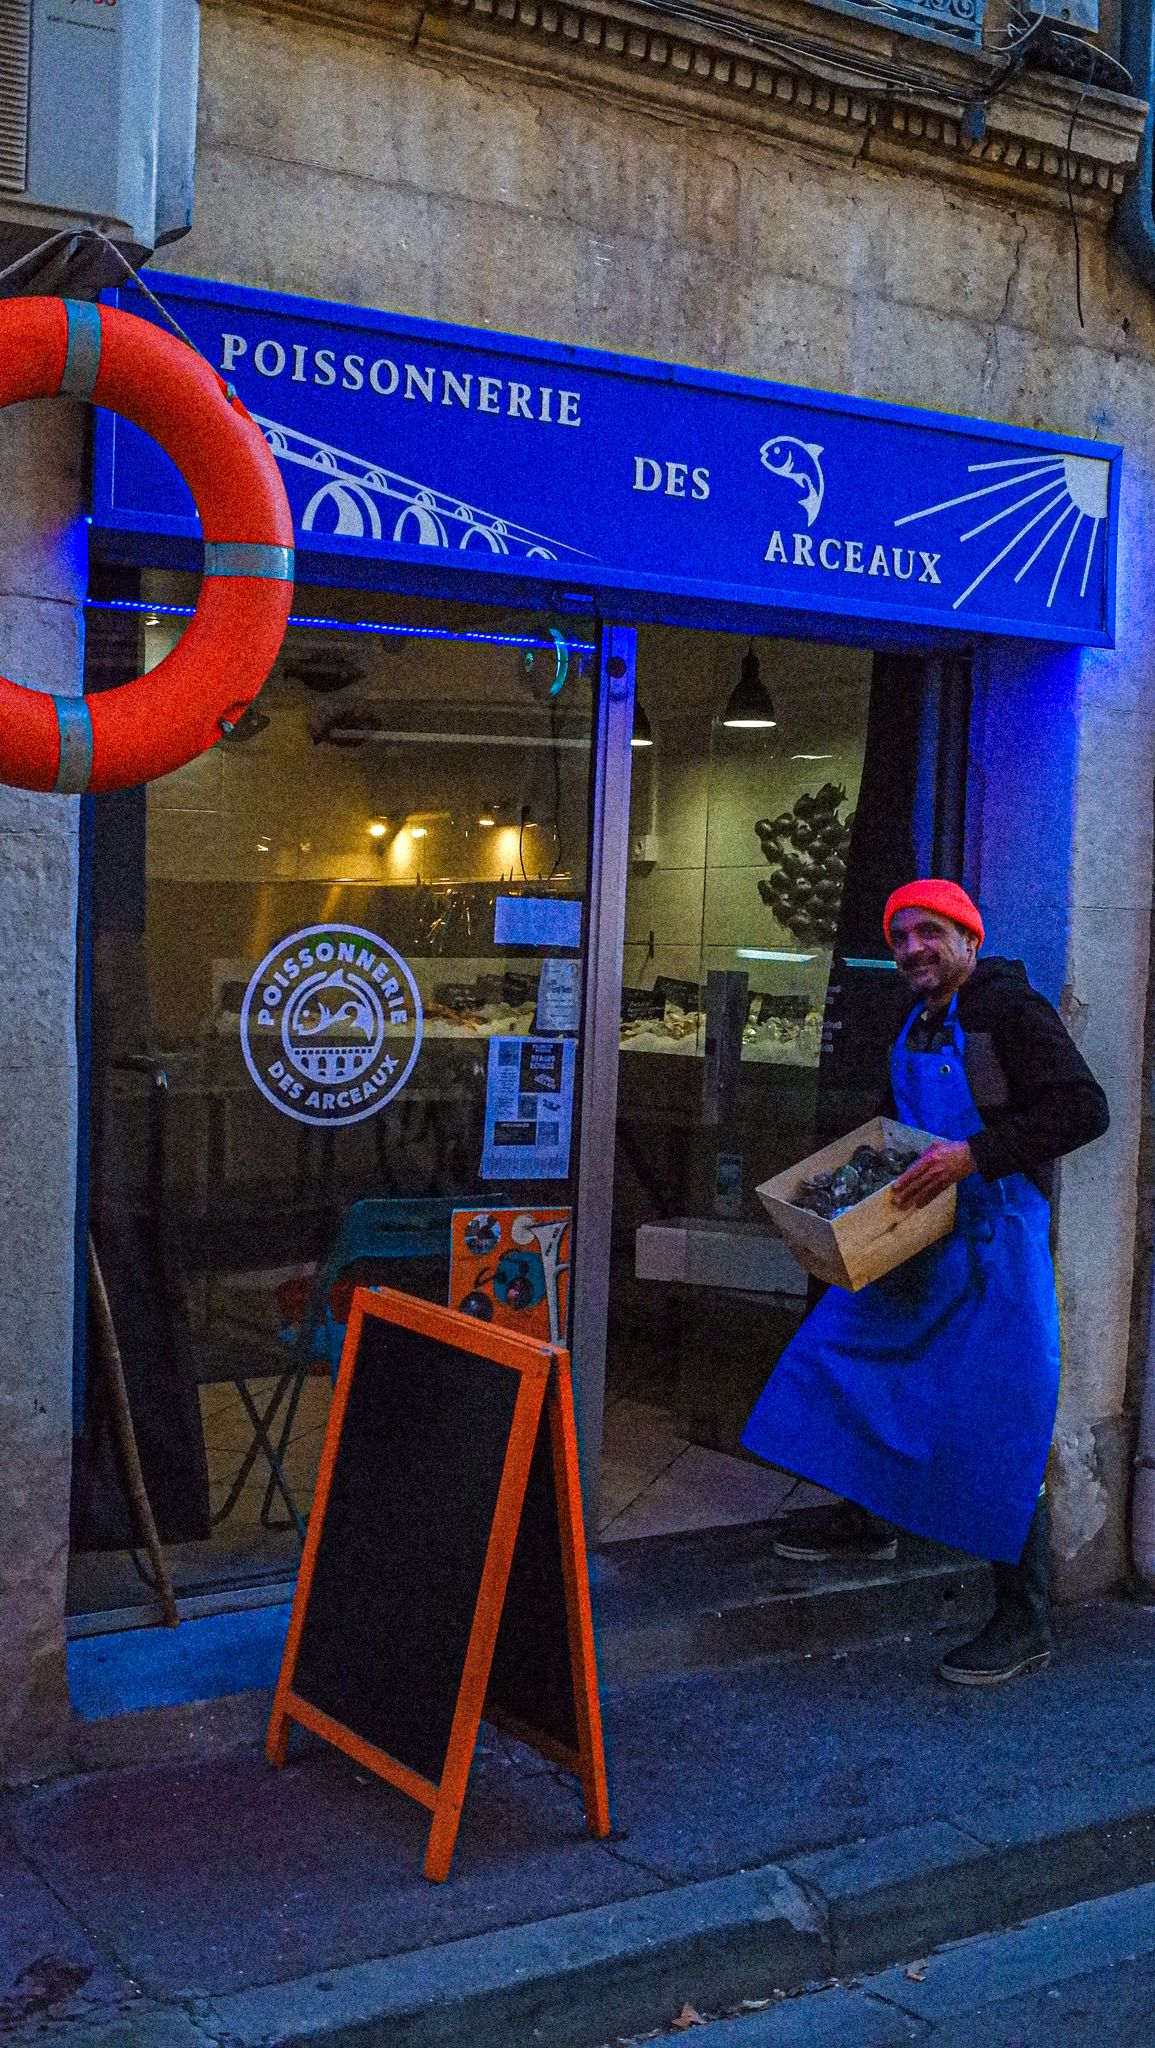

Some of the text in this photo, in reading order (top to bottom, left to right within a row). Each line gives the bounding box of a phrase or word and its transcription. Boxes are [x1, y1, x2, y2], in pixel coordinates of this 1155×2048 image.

[221, 333, 582, 427] POISSONNERIE
[632, 456, 710, 500] DES
[764, 530, 941, 584] ARCEAUX
[257, 942, 408, 1026] POISSONNERIE
[267, 1054, 399, 1110] DES ARCEAUX
